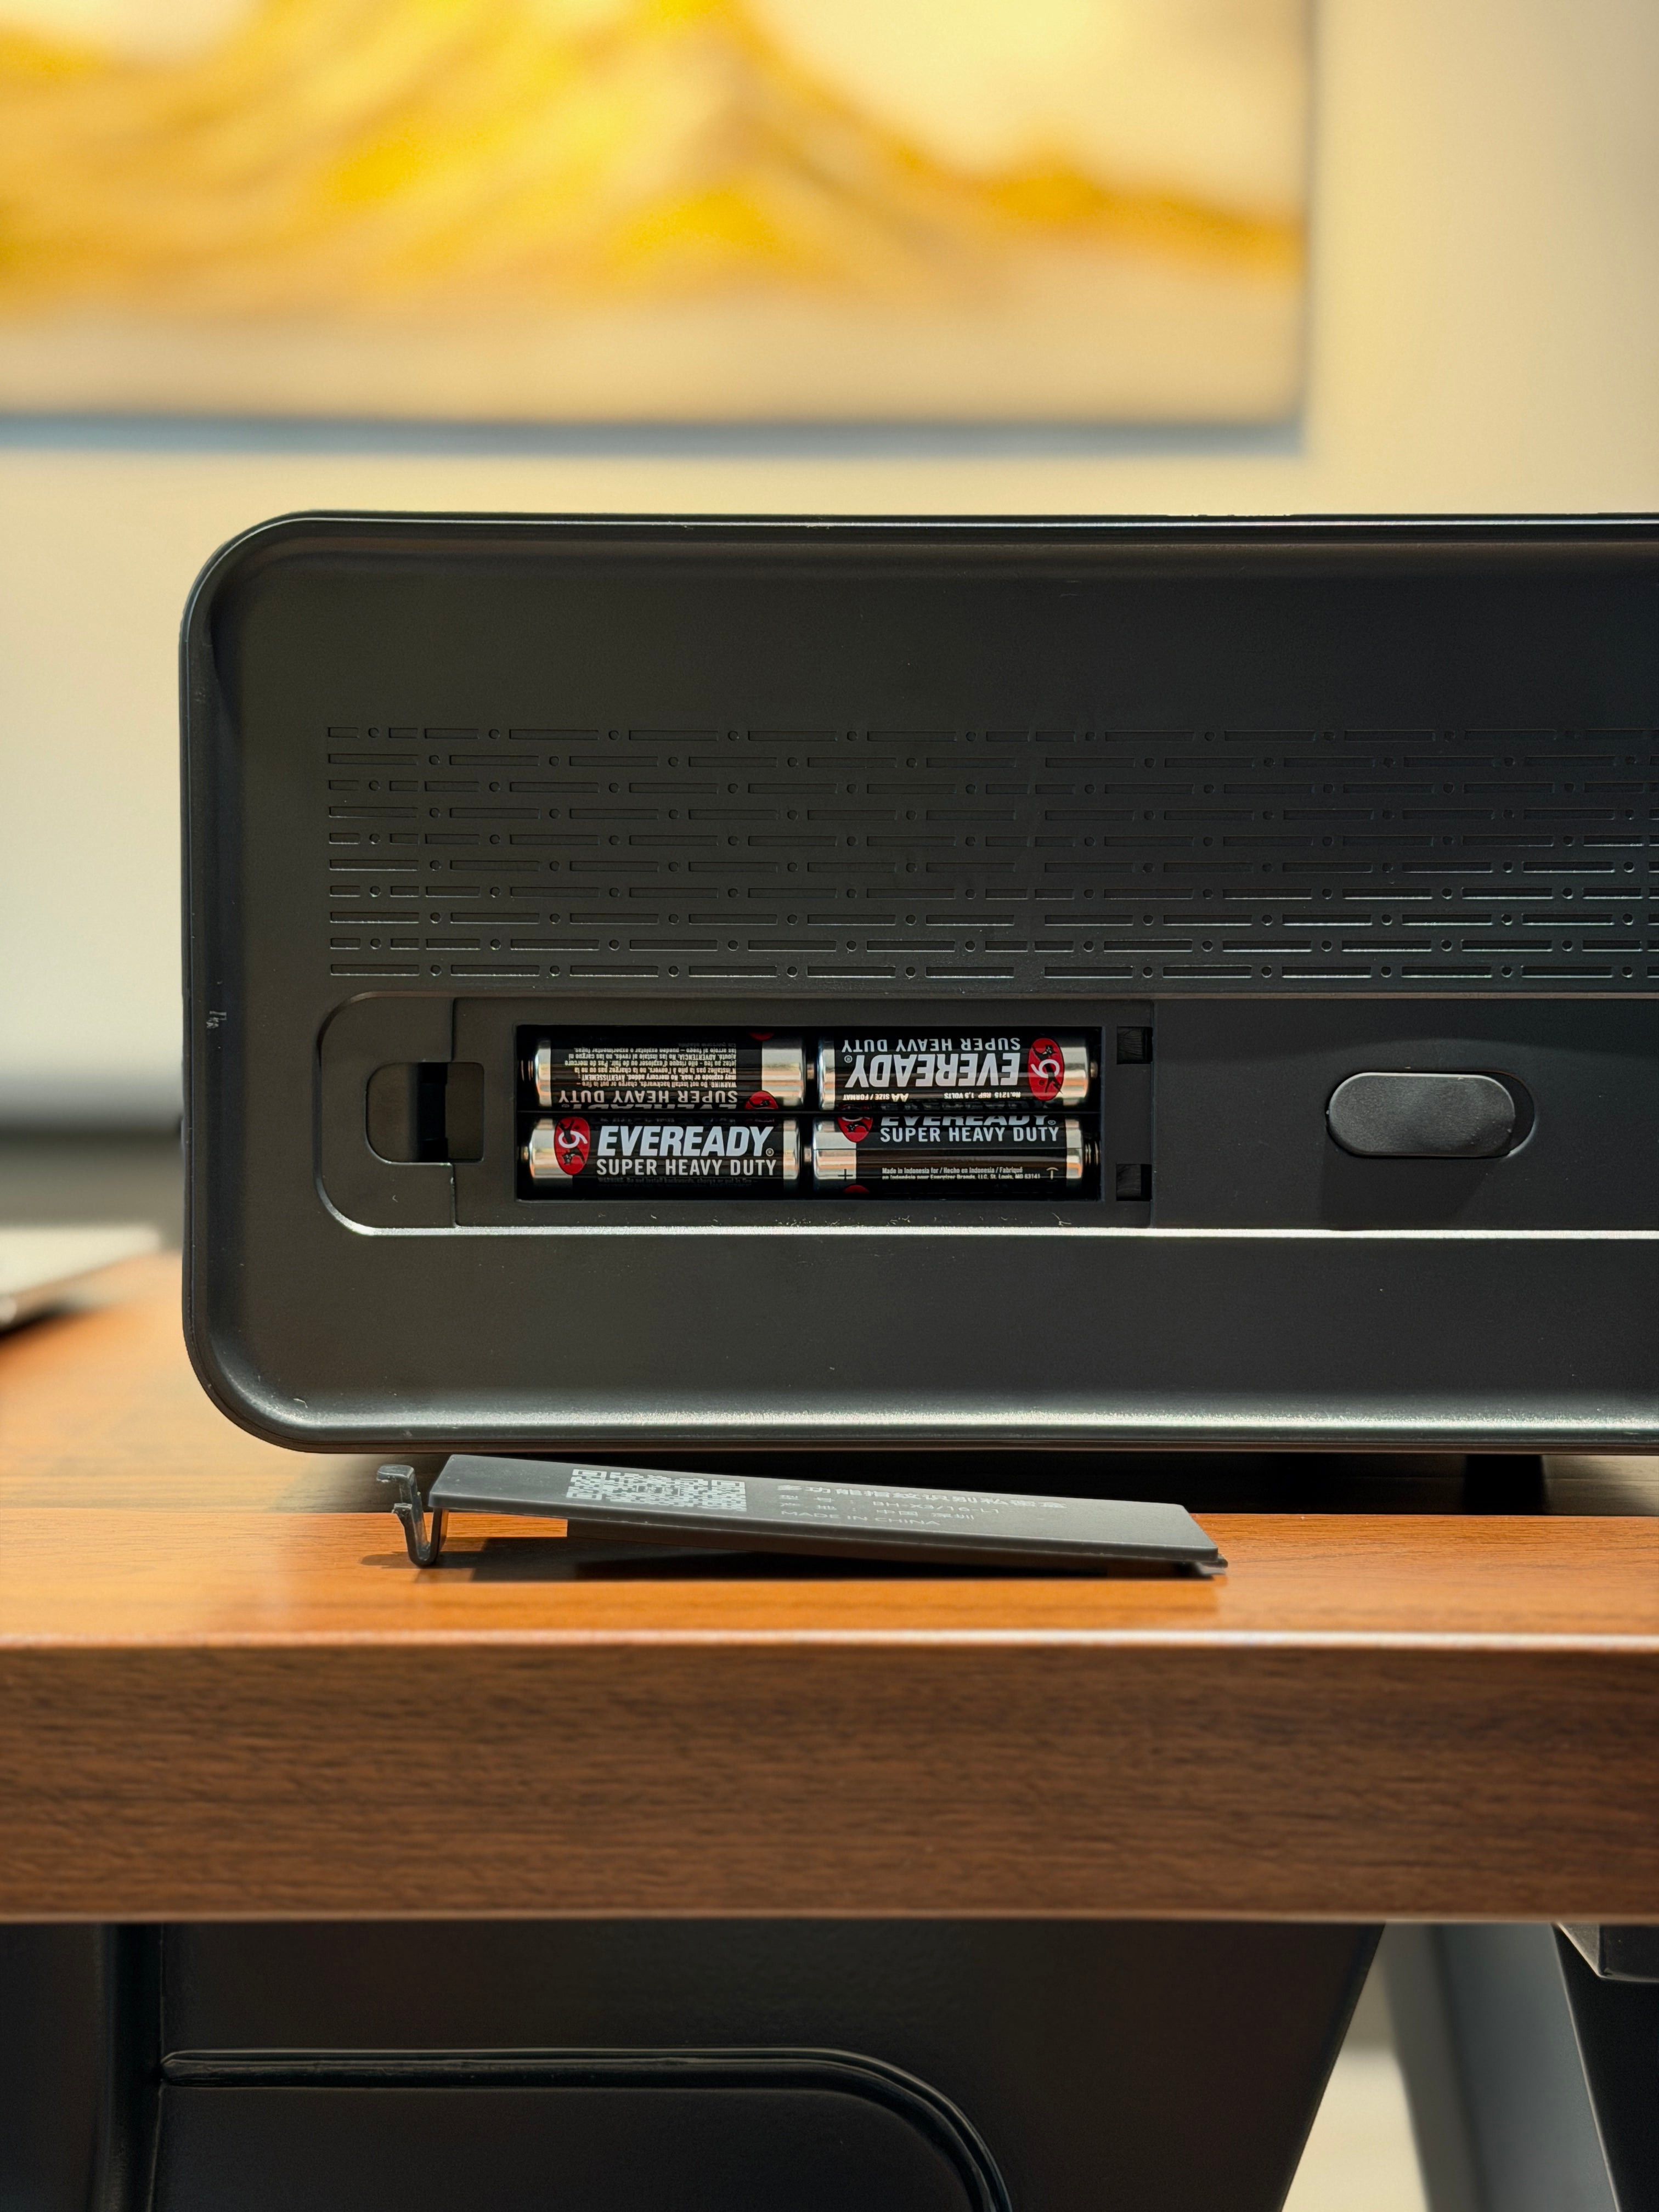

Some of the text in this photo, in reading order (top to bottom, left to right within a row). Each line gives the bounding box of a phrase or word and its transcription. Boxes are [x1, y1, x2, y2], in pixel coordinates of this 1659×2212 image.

[842, 1038, 1020, 1052] SUPER HEAVY DUTY
[558, 1091, 738, 1103] SUPER HEAVY DUTY
[891, 1093, 909, 1102] AA
[880, 1127, 1059, 1142] SUPER HEAVY DUTY
[596, 1159, 776, 1175] SUPER HEAVY DUTY
[781, 1510, 841, 1519] MADE
[874, 1517, 940, 1526] CHINA
